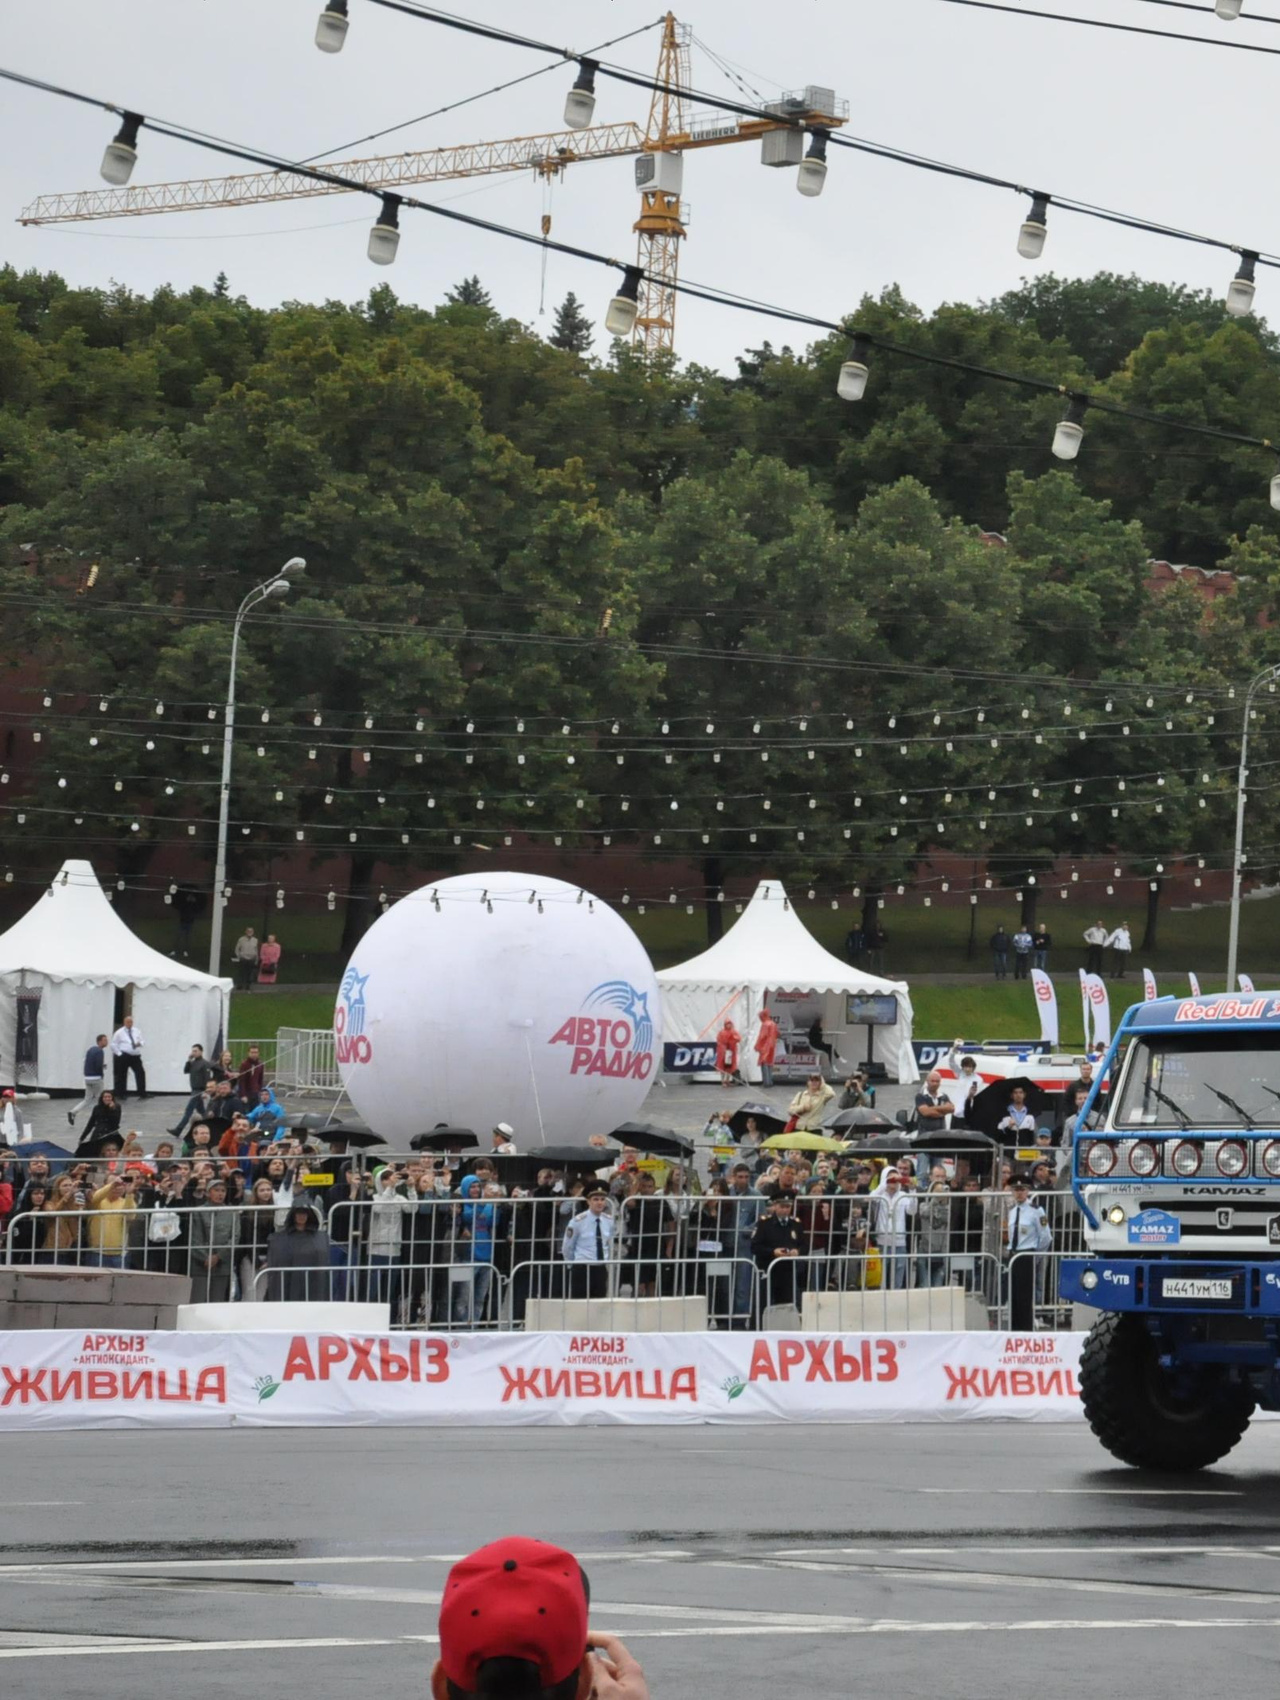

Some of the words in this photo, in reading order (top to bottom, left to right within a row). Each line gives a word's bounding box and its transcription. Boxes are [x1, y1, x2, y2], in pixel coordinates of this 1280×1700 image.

[693, 126, 736, 140] LIEBHERR
[1174, 1001, 1221, 1021] Red
[1219, 998, 1269, 1020] Bull
[548, 1017, 632, 1049] АВТО
[336, 1035, 373, 1065] ДИО
[919, 1046, 949, 1065] DT
[570, 1047, 653, 1081] РАДИО
[1183, 1187, 1266, 1195] KAMAZ
[1131, 1225, 1174, 1233] KAMAZ
[1112, 1275, 1130, 1285] VTB
[1212, 1281, 1229, 1292] 116
[82, 1335, 145, 1352] АРХЫЗ
[569, 1336, 626, 1353] АРХЫЗ
[1004, 1337, 1055, 1353] АРХЫЗ
[282, 1335, 450, 1383] АРХЫЗ
[749, 1339, 898, 1383] АРХЫЗ
[1, 1364, 226, 1403] ЖИВИЦА
[251, 1373, 273, 1392] vita
[500, 1365, 697, 1401] ЖИВИЦА
[720, 1375, 741, 1393] vita
[944, 1364, 1081, 1401] ЖИВИЦ
